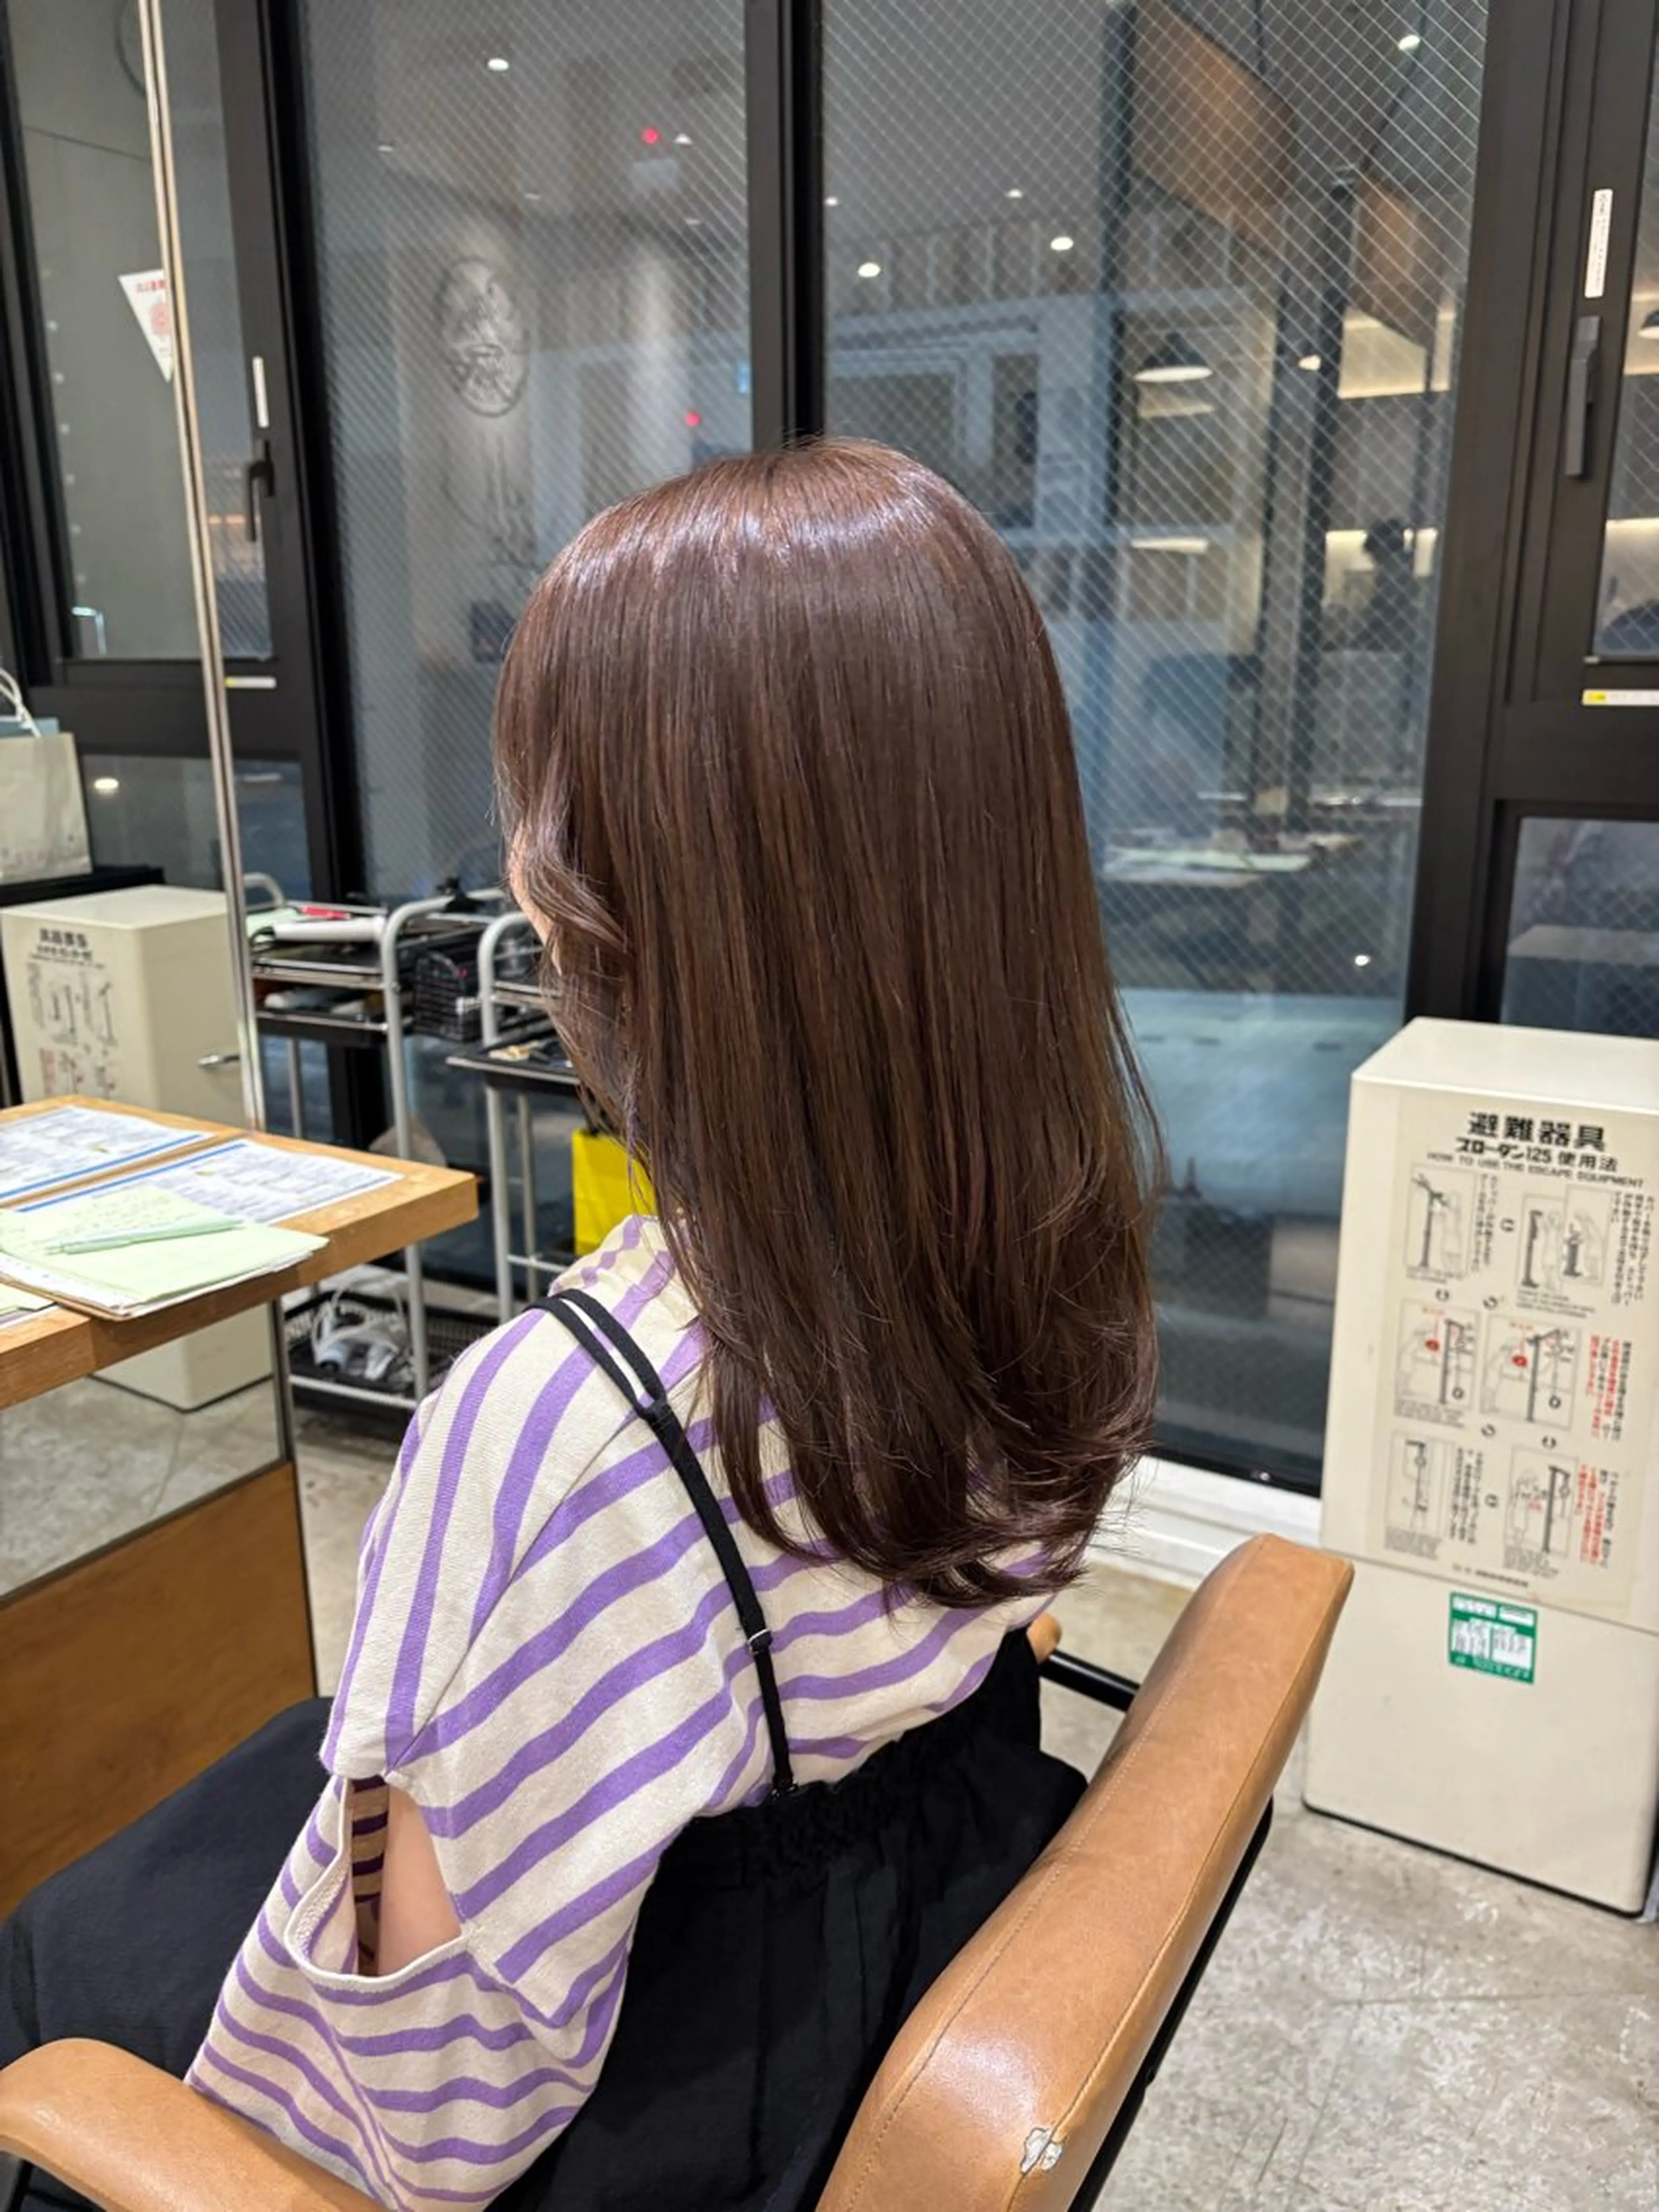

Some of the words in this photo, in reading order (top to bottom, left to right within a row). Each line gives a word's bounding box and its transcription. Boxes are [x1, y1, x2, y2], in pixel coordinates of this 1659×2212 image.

[1468, 1111, 1605, 1152] 避難器具
[1459, 1154, 1474, 1166] TO
[1478, 1158, 1500, 1170] USE
[1502, 1160, 1525, 1172] THE
[1528, 1164, 1573, 1180] ESCAPE
[1577, 1170, 1644, 1188] EQUIPMENT
[1558, 1151, 1618, 1172] 使用法
